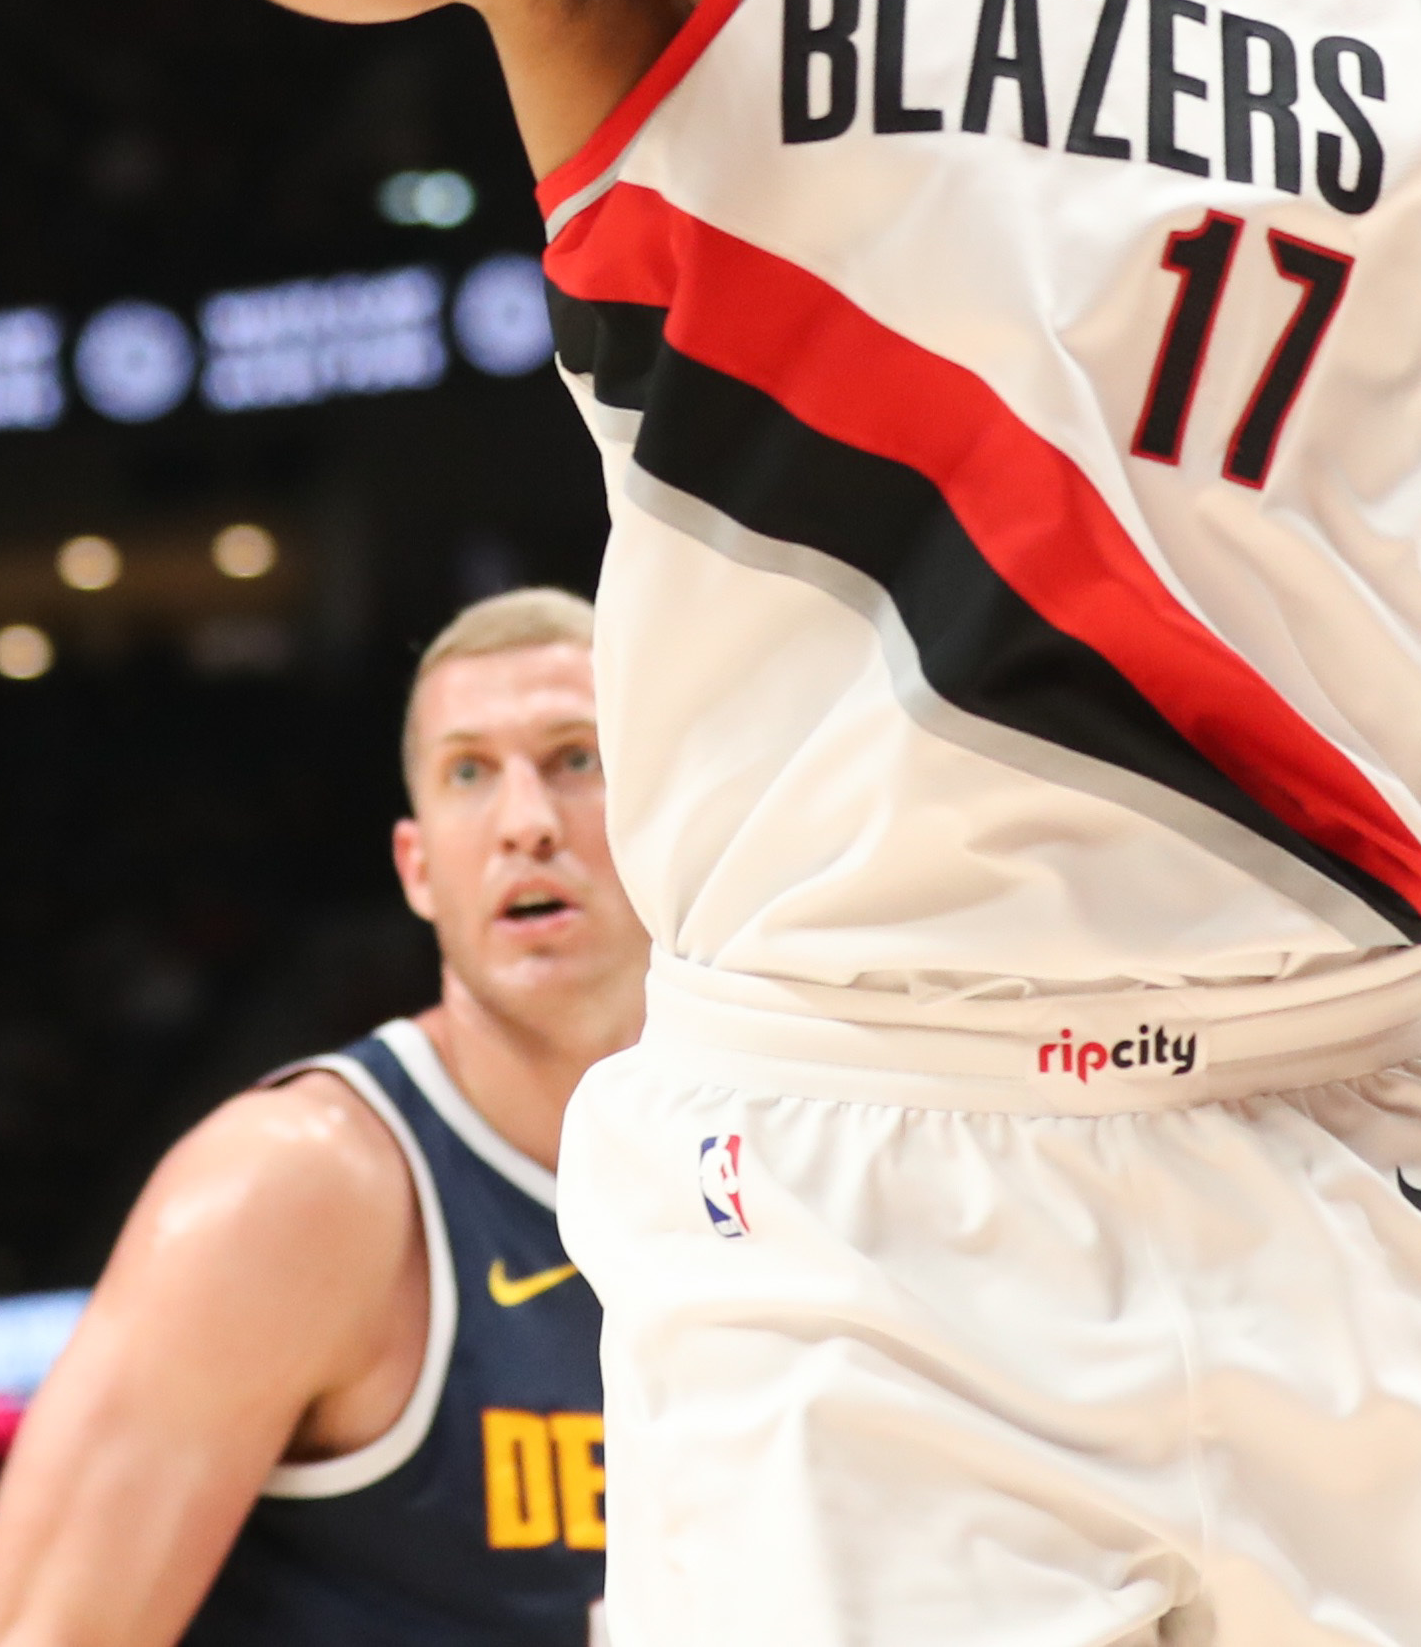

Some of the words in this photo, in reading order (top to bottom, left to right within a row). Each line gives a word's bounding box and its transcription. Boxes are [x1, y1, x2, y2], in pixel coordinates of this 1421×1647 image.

[1131, 208, 1355, 491] 17
[1038, 1024, 1197, 1086] ripcity
[481, 1406, 606, 1551] DE
